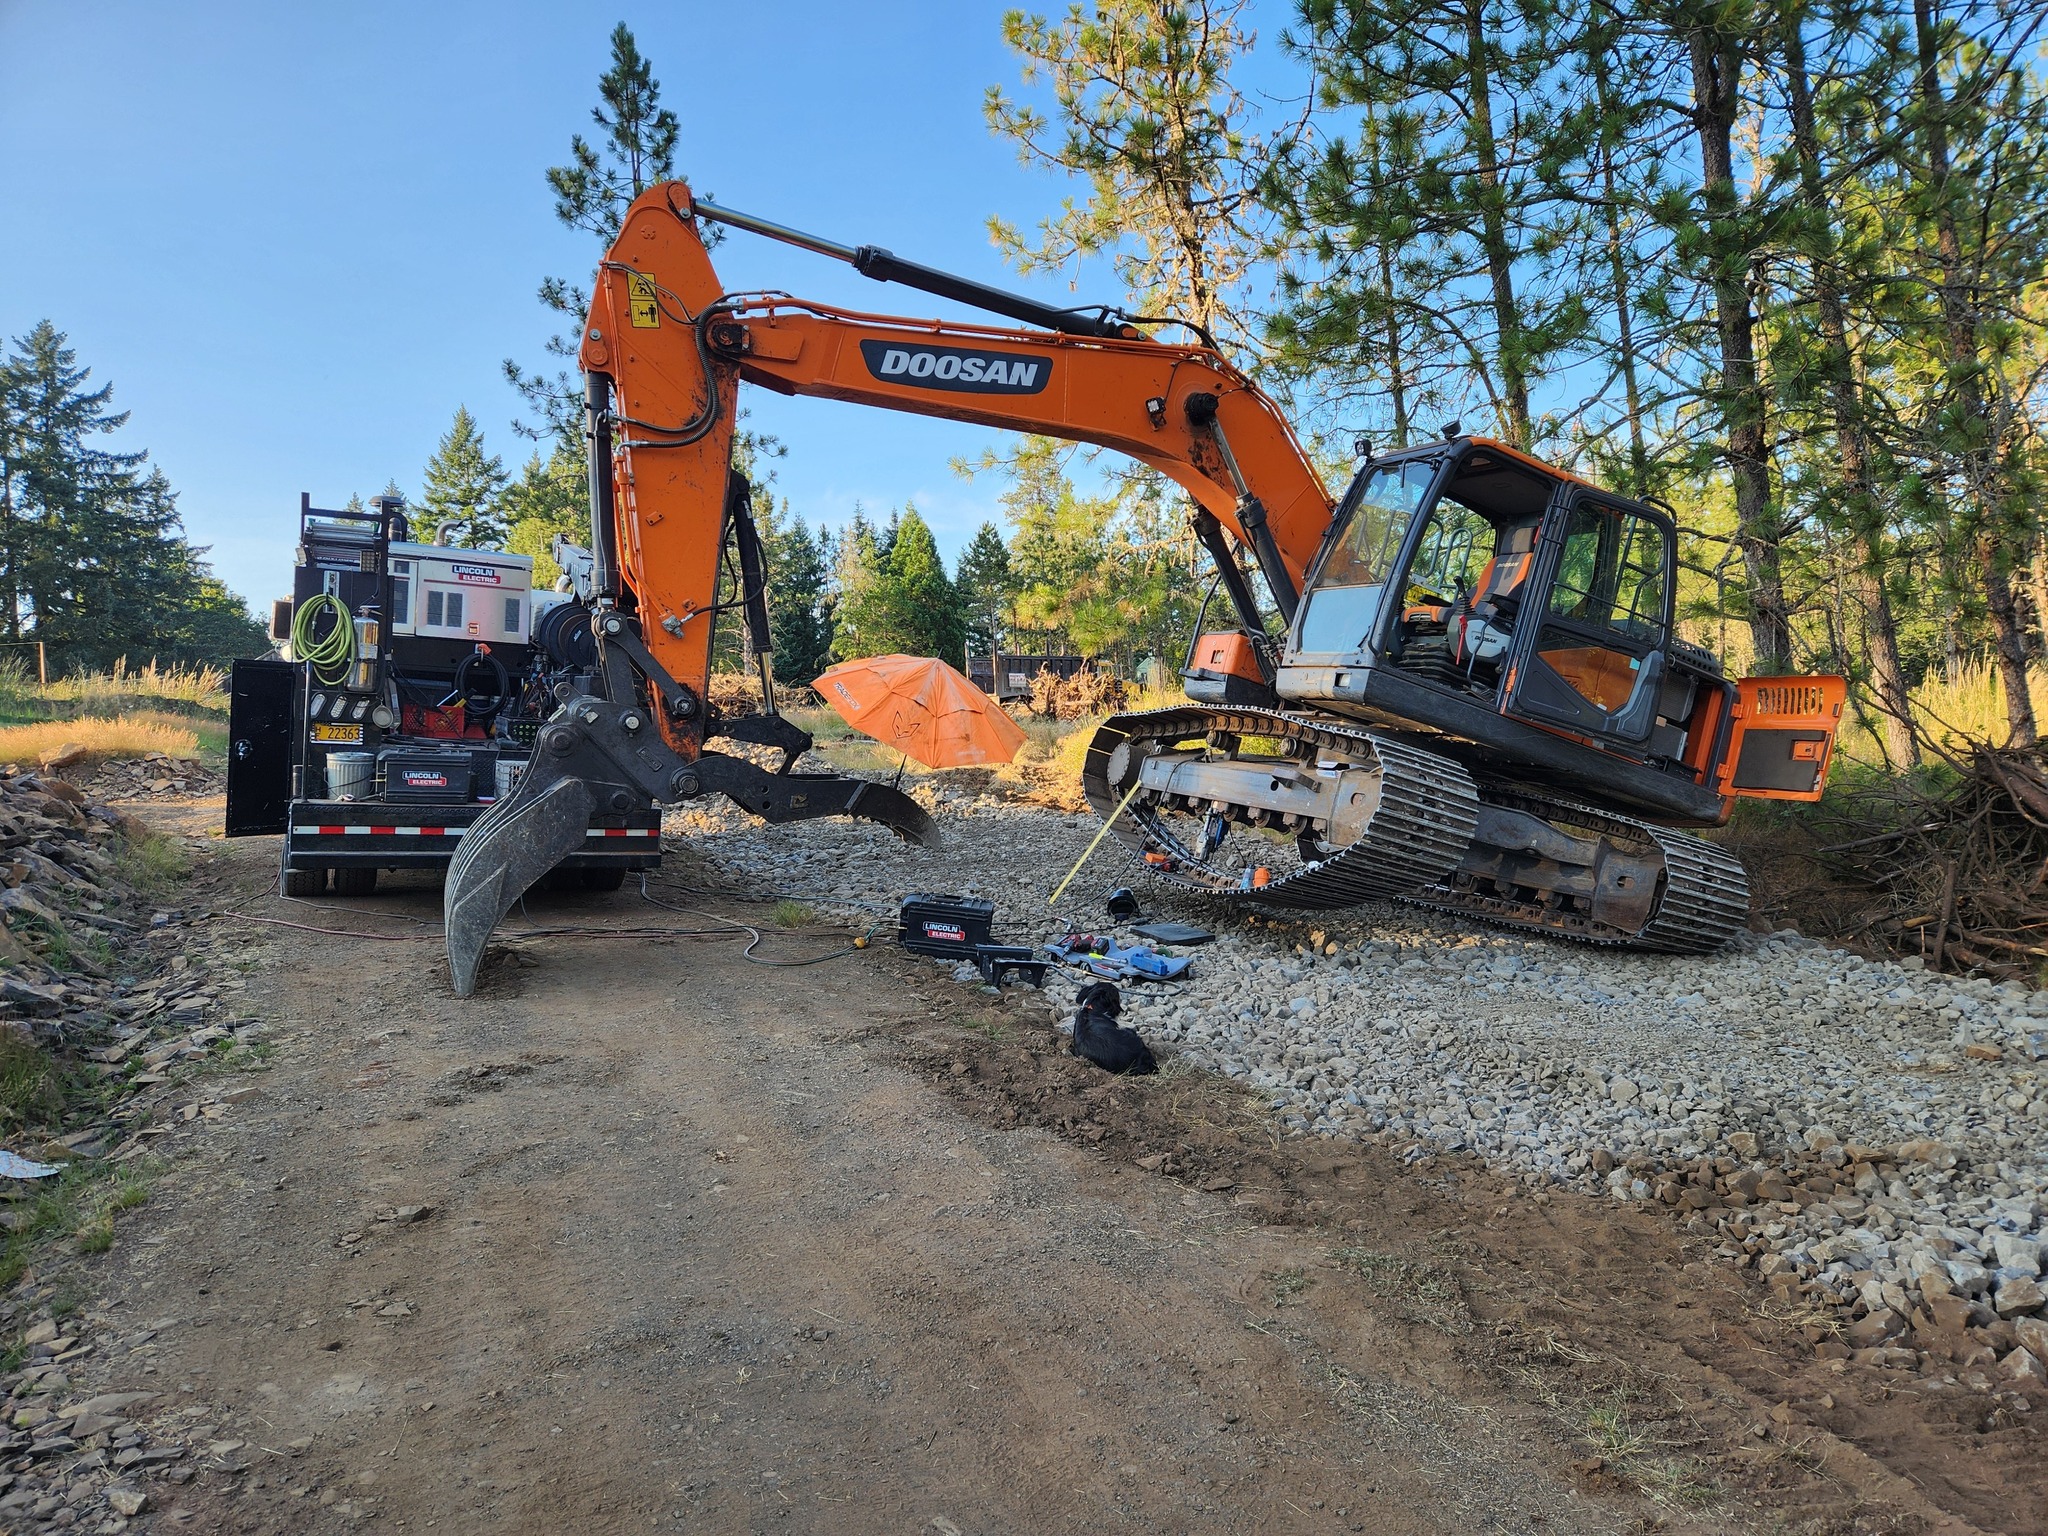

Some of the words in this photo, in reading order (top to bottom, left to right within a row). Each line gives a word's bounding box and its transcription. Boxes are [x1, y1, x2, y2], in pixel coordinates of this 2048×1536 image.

[880, 350, 1038, 386] DOOSAN
[454, 566, 493, 576] LINCOLN
[462, 574, 497, 583] ELECTRIC
[327, 727, 360, 740] 22363
[925, 923, 958, 932] LINCOLN
[931, 931, 961, 939] ELECTRIC
